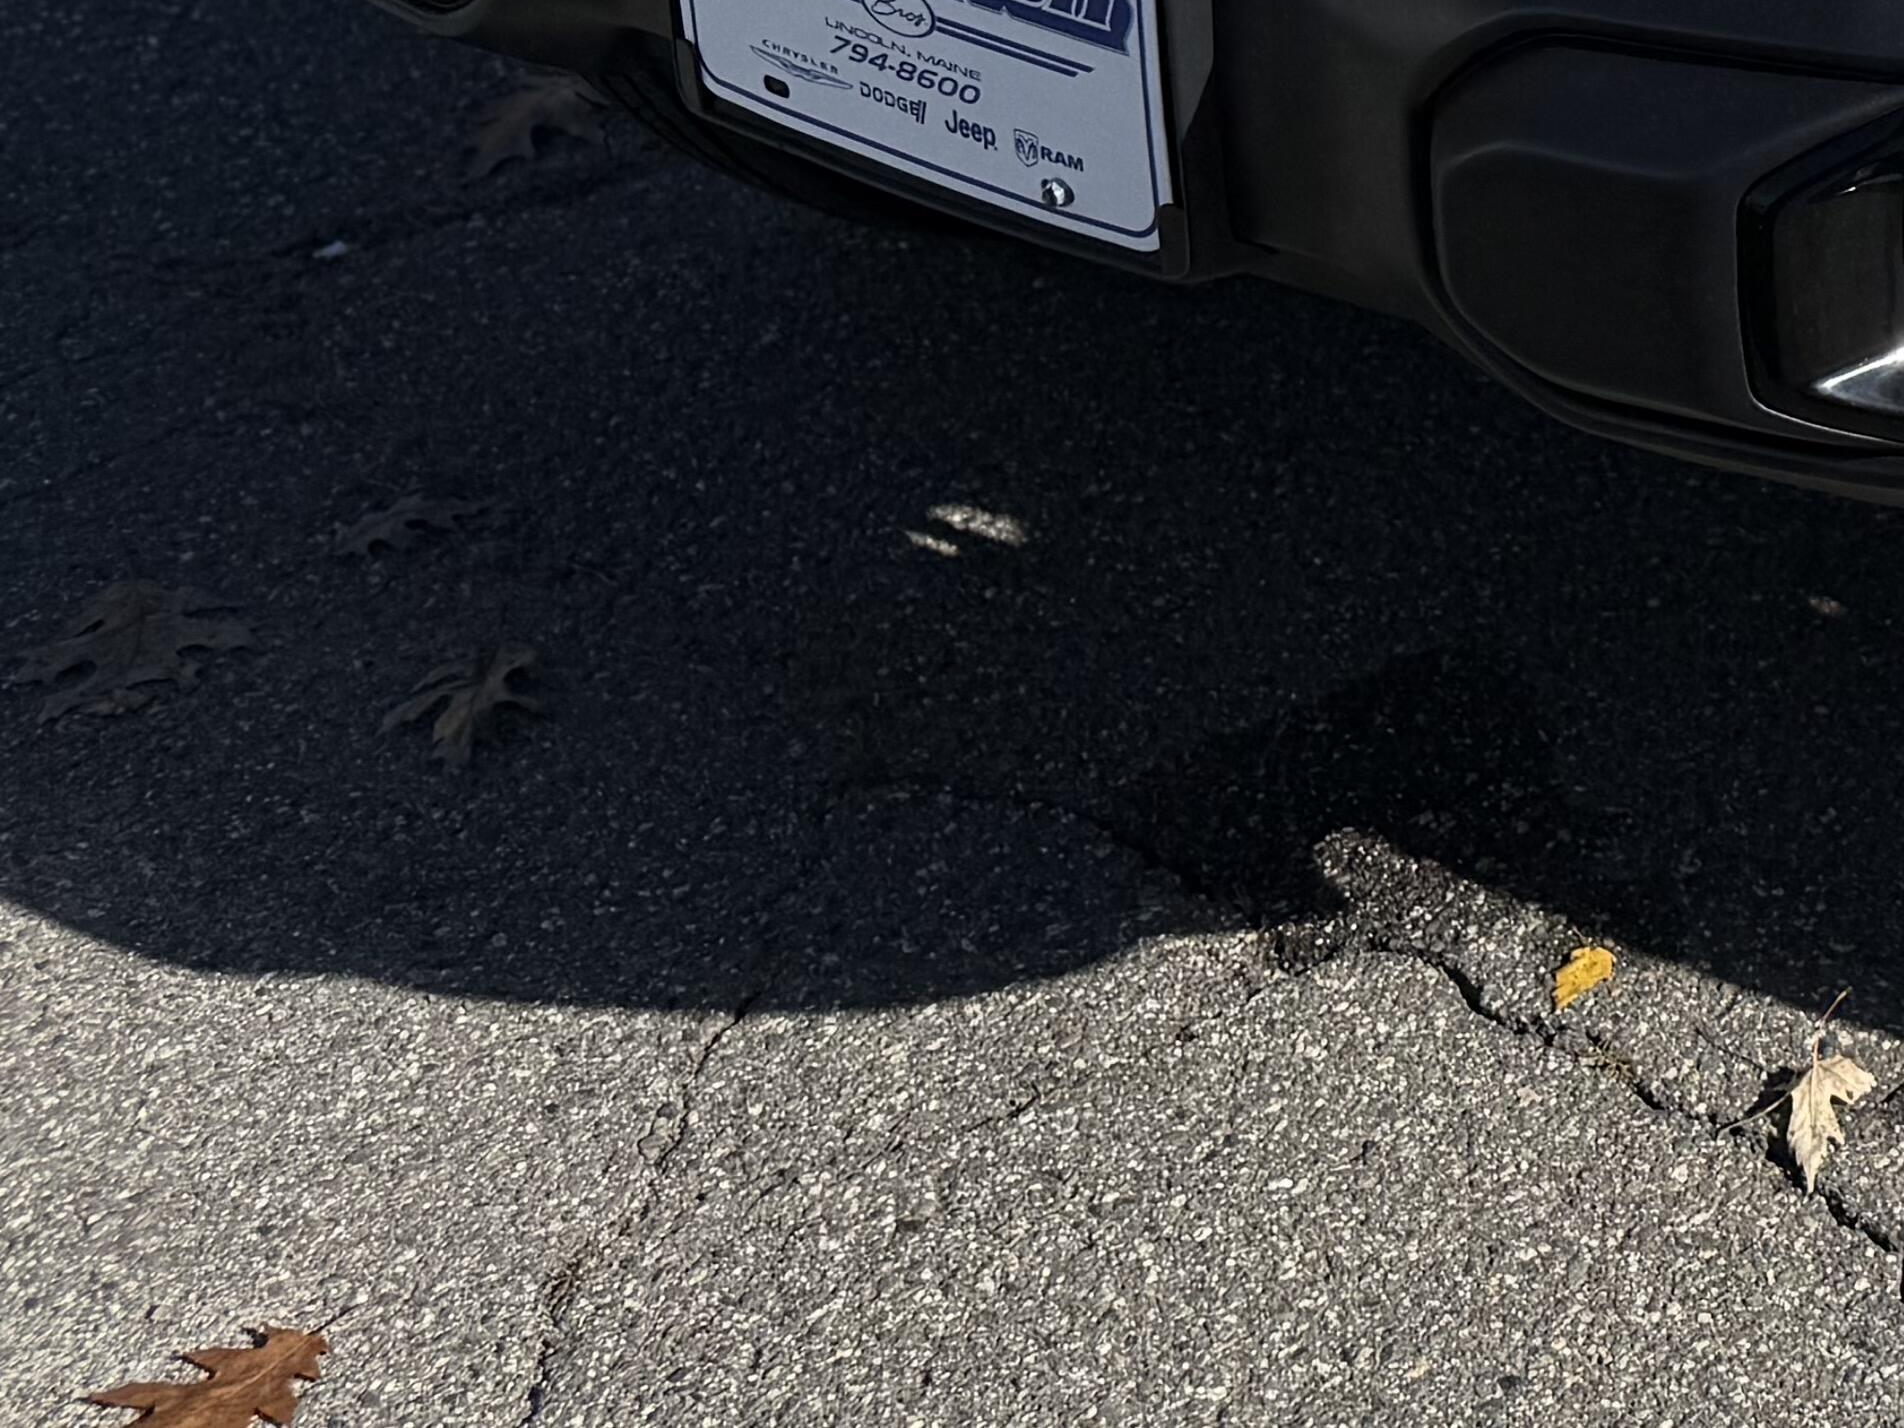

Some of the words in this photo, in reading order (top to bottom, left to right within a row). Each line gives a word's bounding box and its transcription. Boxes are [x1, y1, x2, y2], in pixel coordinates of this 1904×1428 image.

[761, 39, 839, 76] CHRYSLER
[829, 35, 982, 105] 794-8600
[916, 51, 982, 82] MAINE
[859, 80, 926, 124] DODGE
[1040, 145, 1085, 173] RAM
